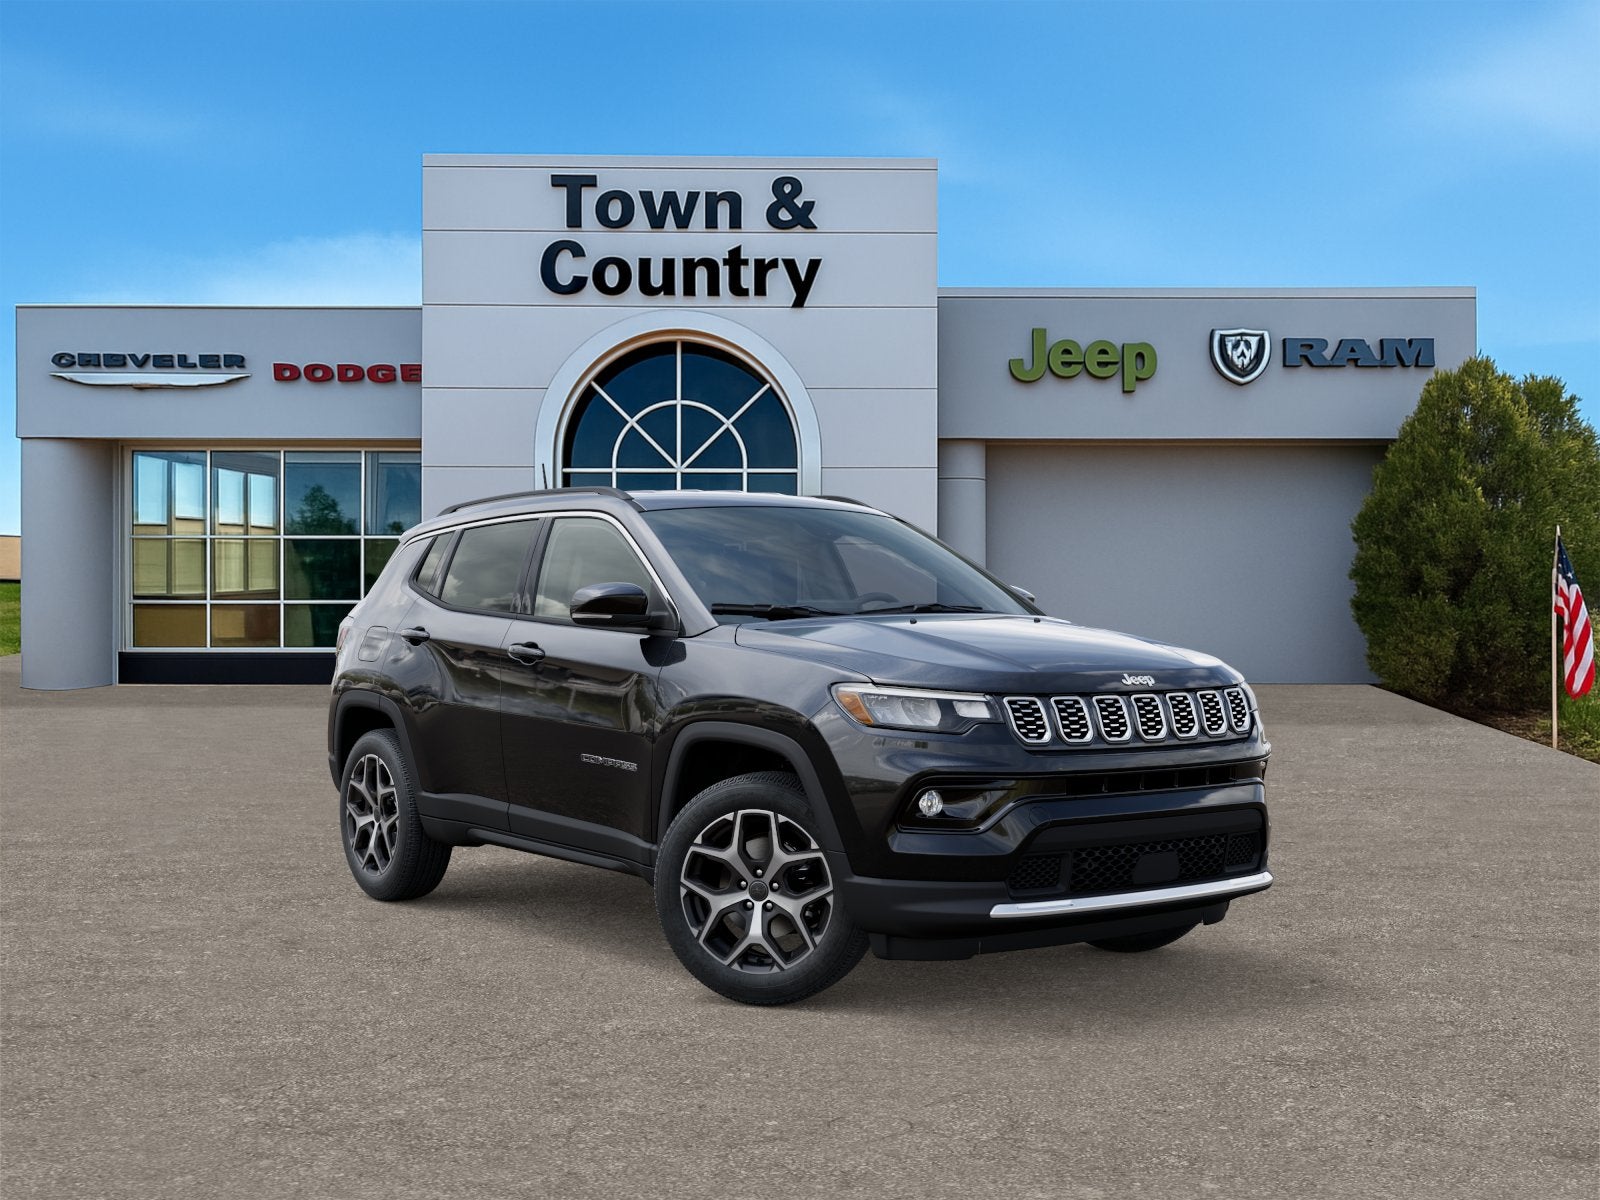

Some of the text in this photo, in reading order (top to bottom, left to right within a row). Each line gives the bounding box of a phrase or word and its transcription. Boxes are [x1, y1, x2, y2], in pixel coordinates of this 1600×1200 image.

[550, 174, 818, 230] Town &
[539, 239, 823, 308] Country
[272, 362, 422, 383] DODGE
[1008, 327, 1158, 393] Jeep
[1282, 337, 1436, 368] RAM
[1121, 673, 1156, 687] Jeep
